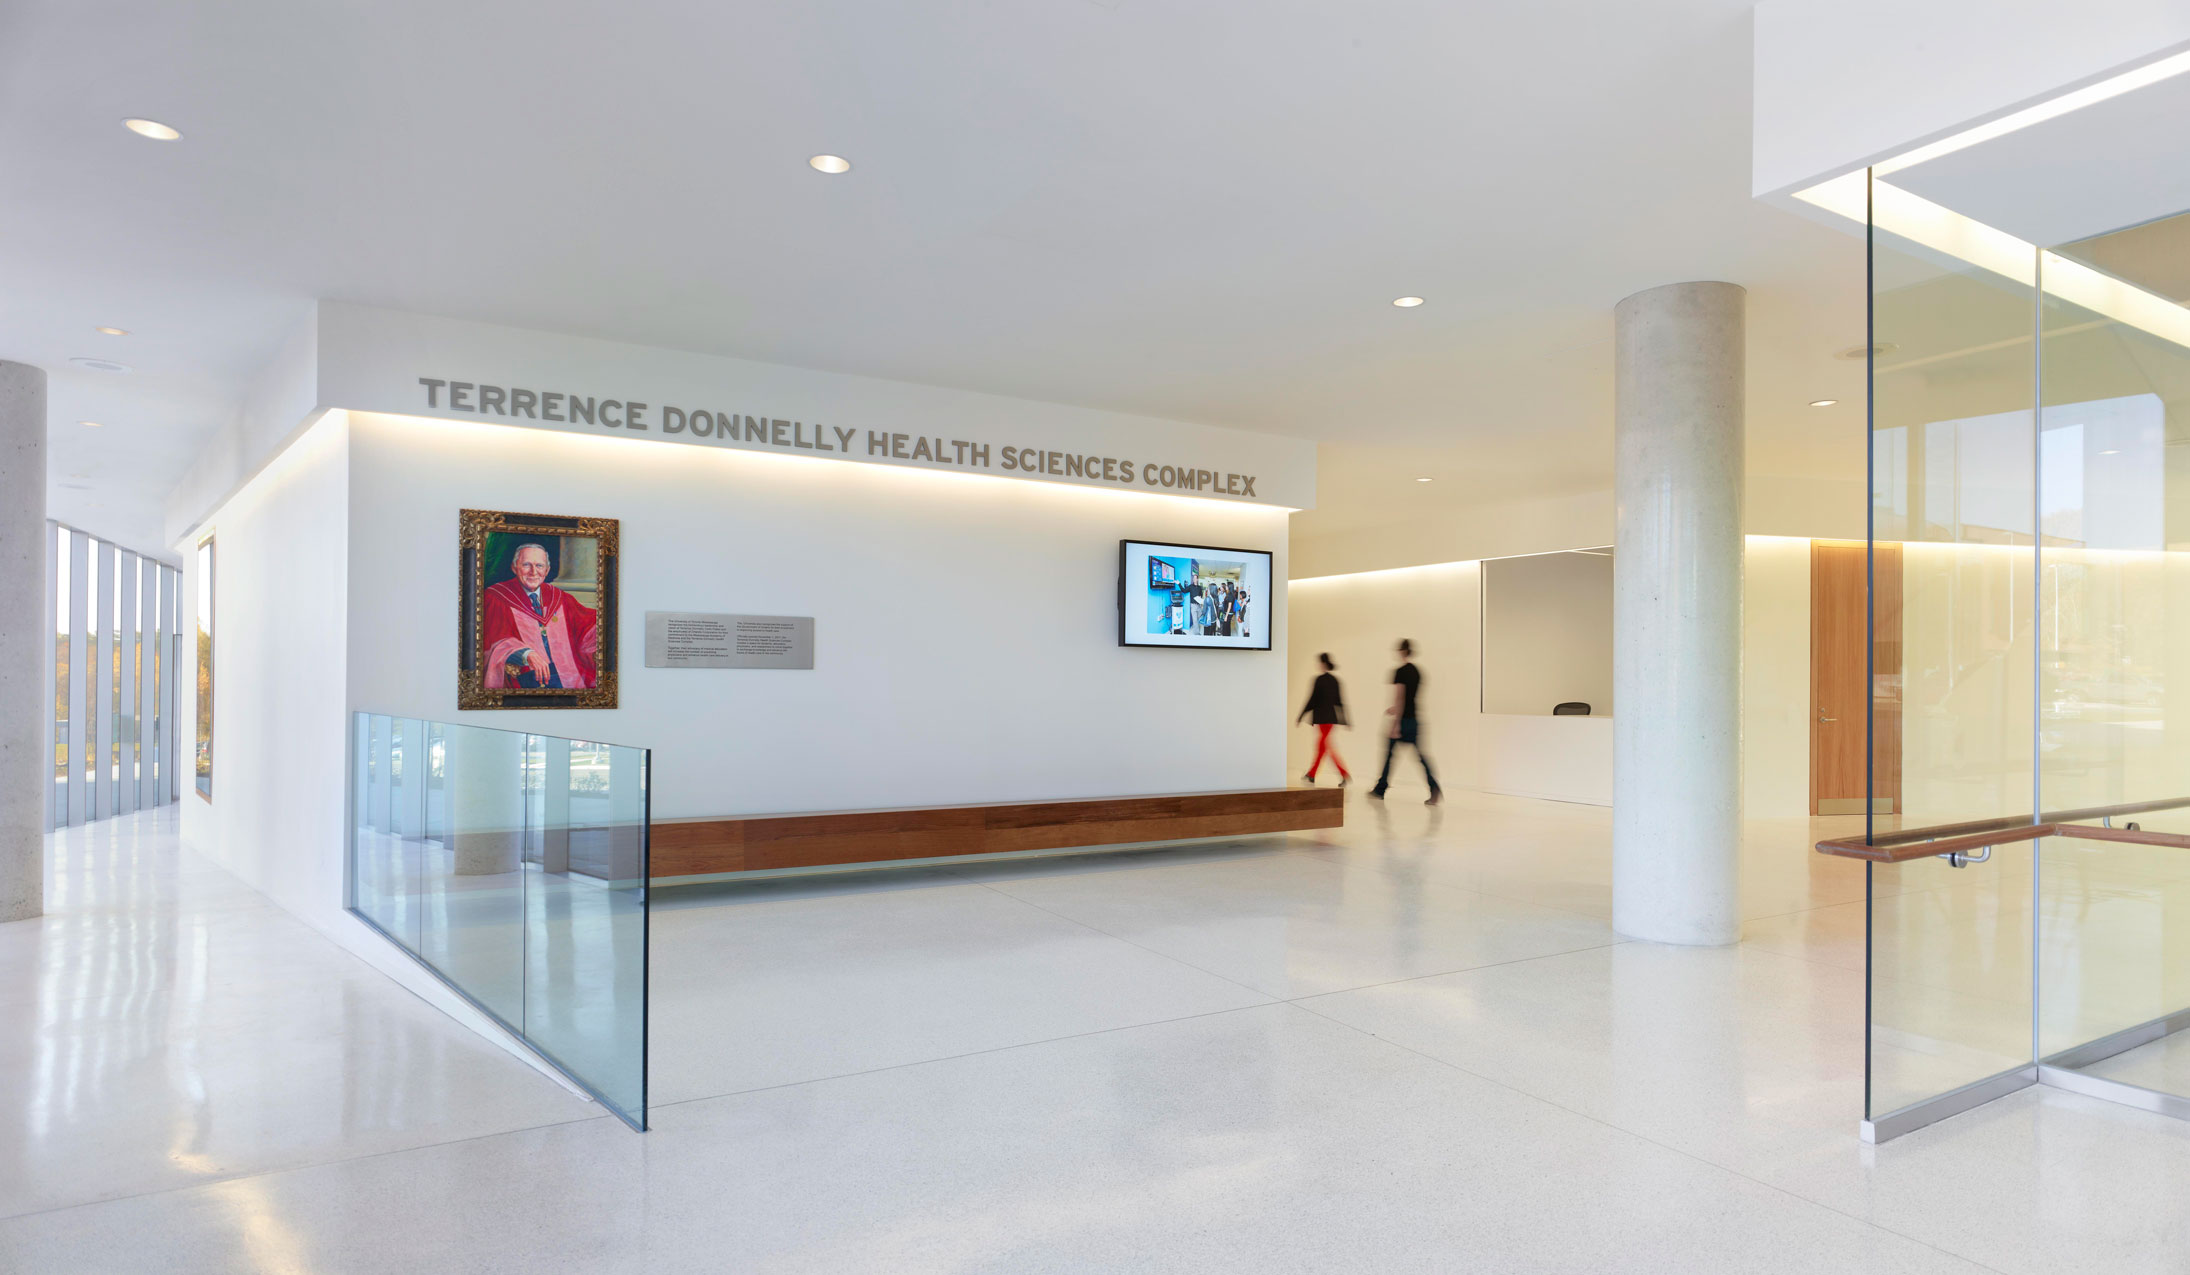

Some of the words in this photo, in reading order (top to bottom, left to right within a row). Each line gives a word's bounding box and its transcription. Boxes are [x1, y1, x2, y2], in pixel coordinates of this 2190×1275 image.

[419, 378, 648, 431] TERRENCE
[662, 406, 856, 452] DONNELLY
[868, 430, 990, 468] HEALTH
[1000, 445, 1135, 485] SCIENCES
[1143, 463, 1257, 497] COMPLEX
